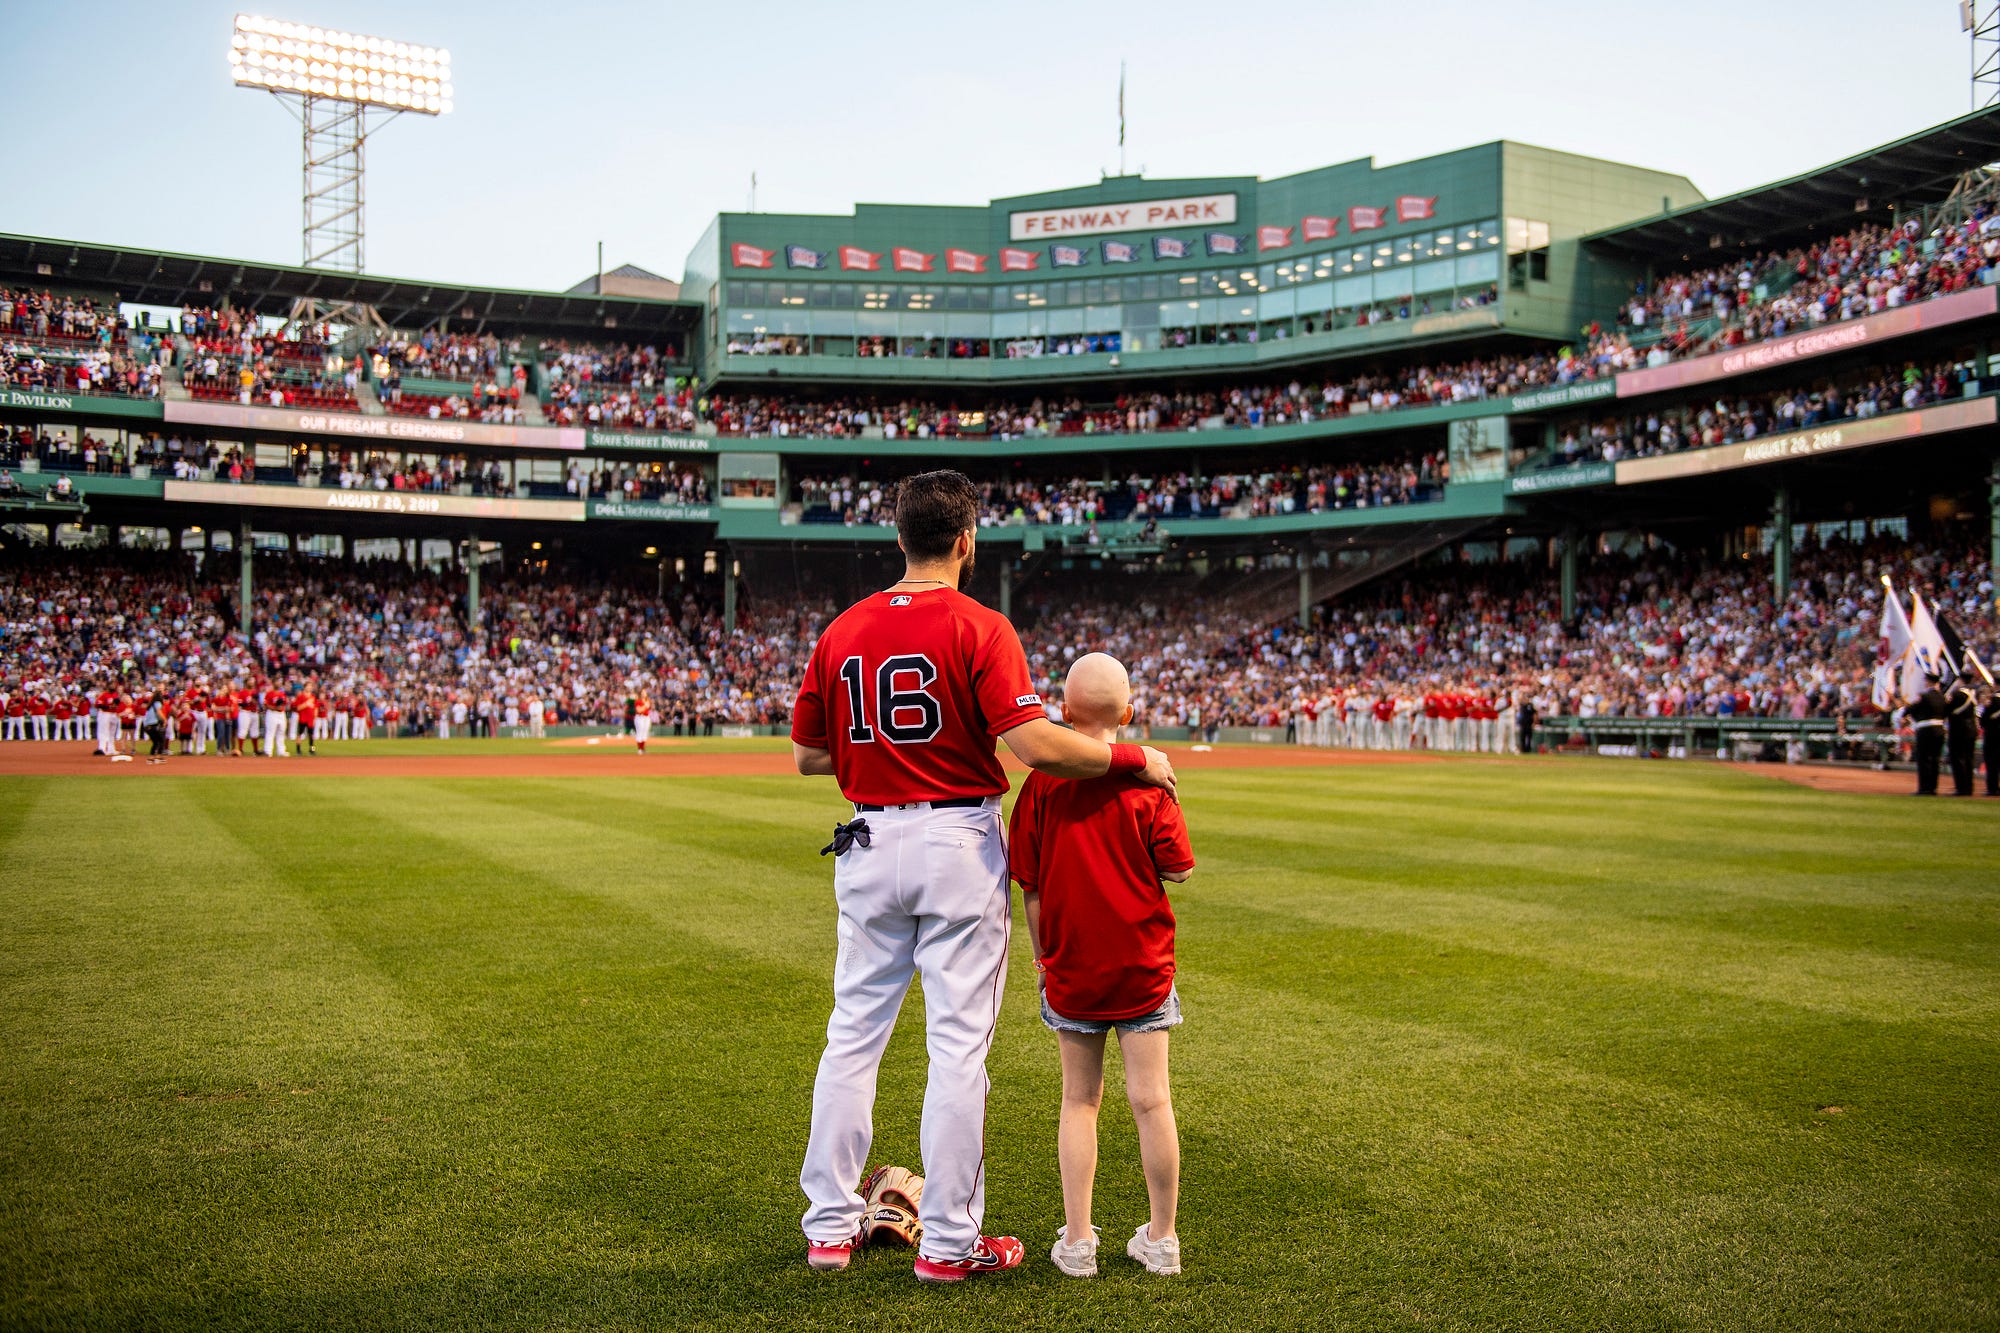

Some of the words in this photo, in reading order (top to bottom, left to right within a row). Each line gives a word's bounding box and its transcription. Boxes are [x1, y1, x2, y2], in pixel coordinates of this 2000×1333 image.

[1025, 210, 1131, 234] FENWAY
[1147, 201, 1219, 223] PARK
[1722, 353, 1744, 373] OUR
[1796, 324, 1868, 355] CEREMONIES
[12, 392, 72, 408] PAVILION
[300, 415, 327, 430] OUR
[329, 417, 388, 435] PREGAME
[391, 420, 464, 440] CEREMONIES
[591, 433, 621, 447] STATE
[623, 434, 659, 448] STREET
[661, 436, 708, 449] PAVILION
[1743, 438, 1788, 462] AUGUST
[1813, 430, 1842, 450] 2019
[327, 493, 381, 510] AUGUST
[383, 496, 406, 512] 20,
[409, 498, 440, 512] 2019
[595, 503, 624, 516] DELL
[840, 653, 943, 744] 16
